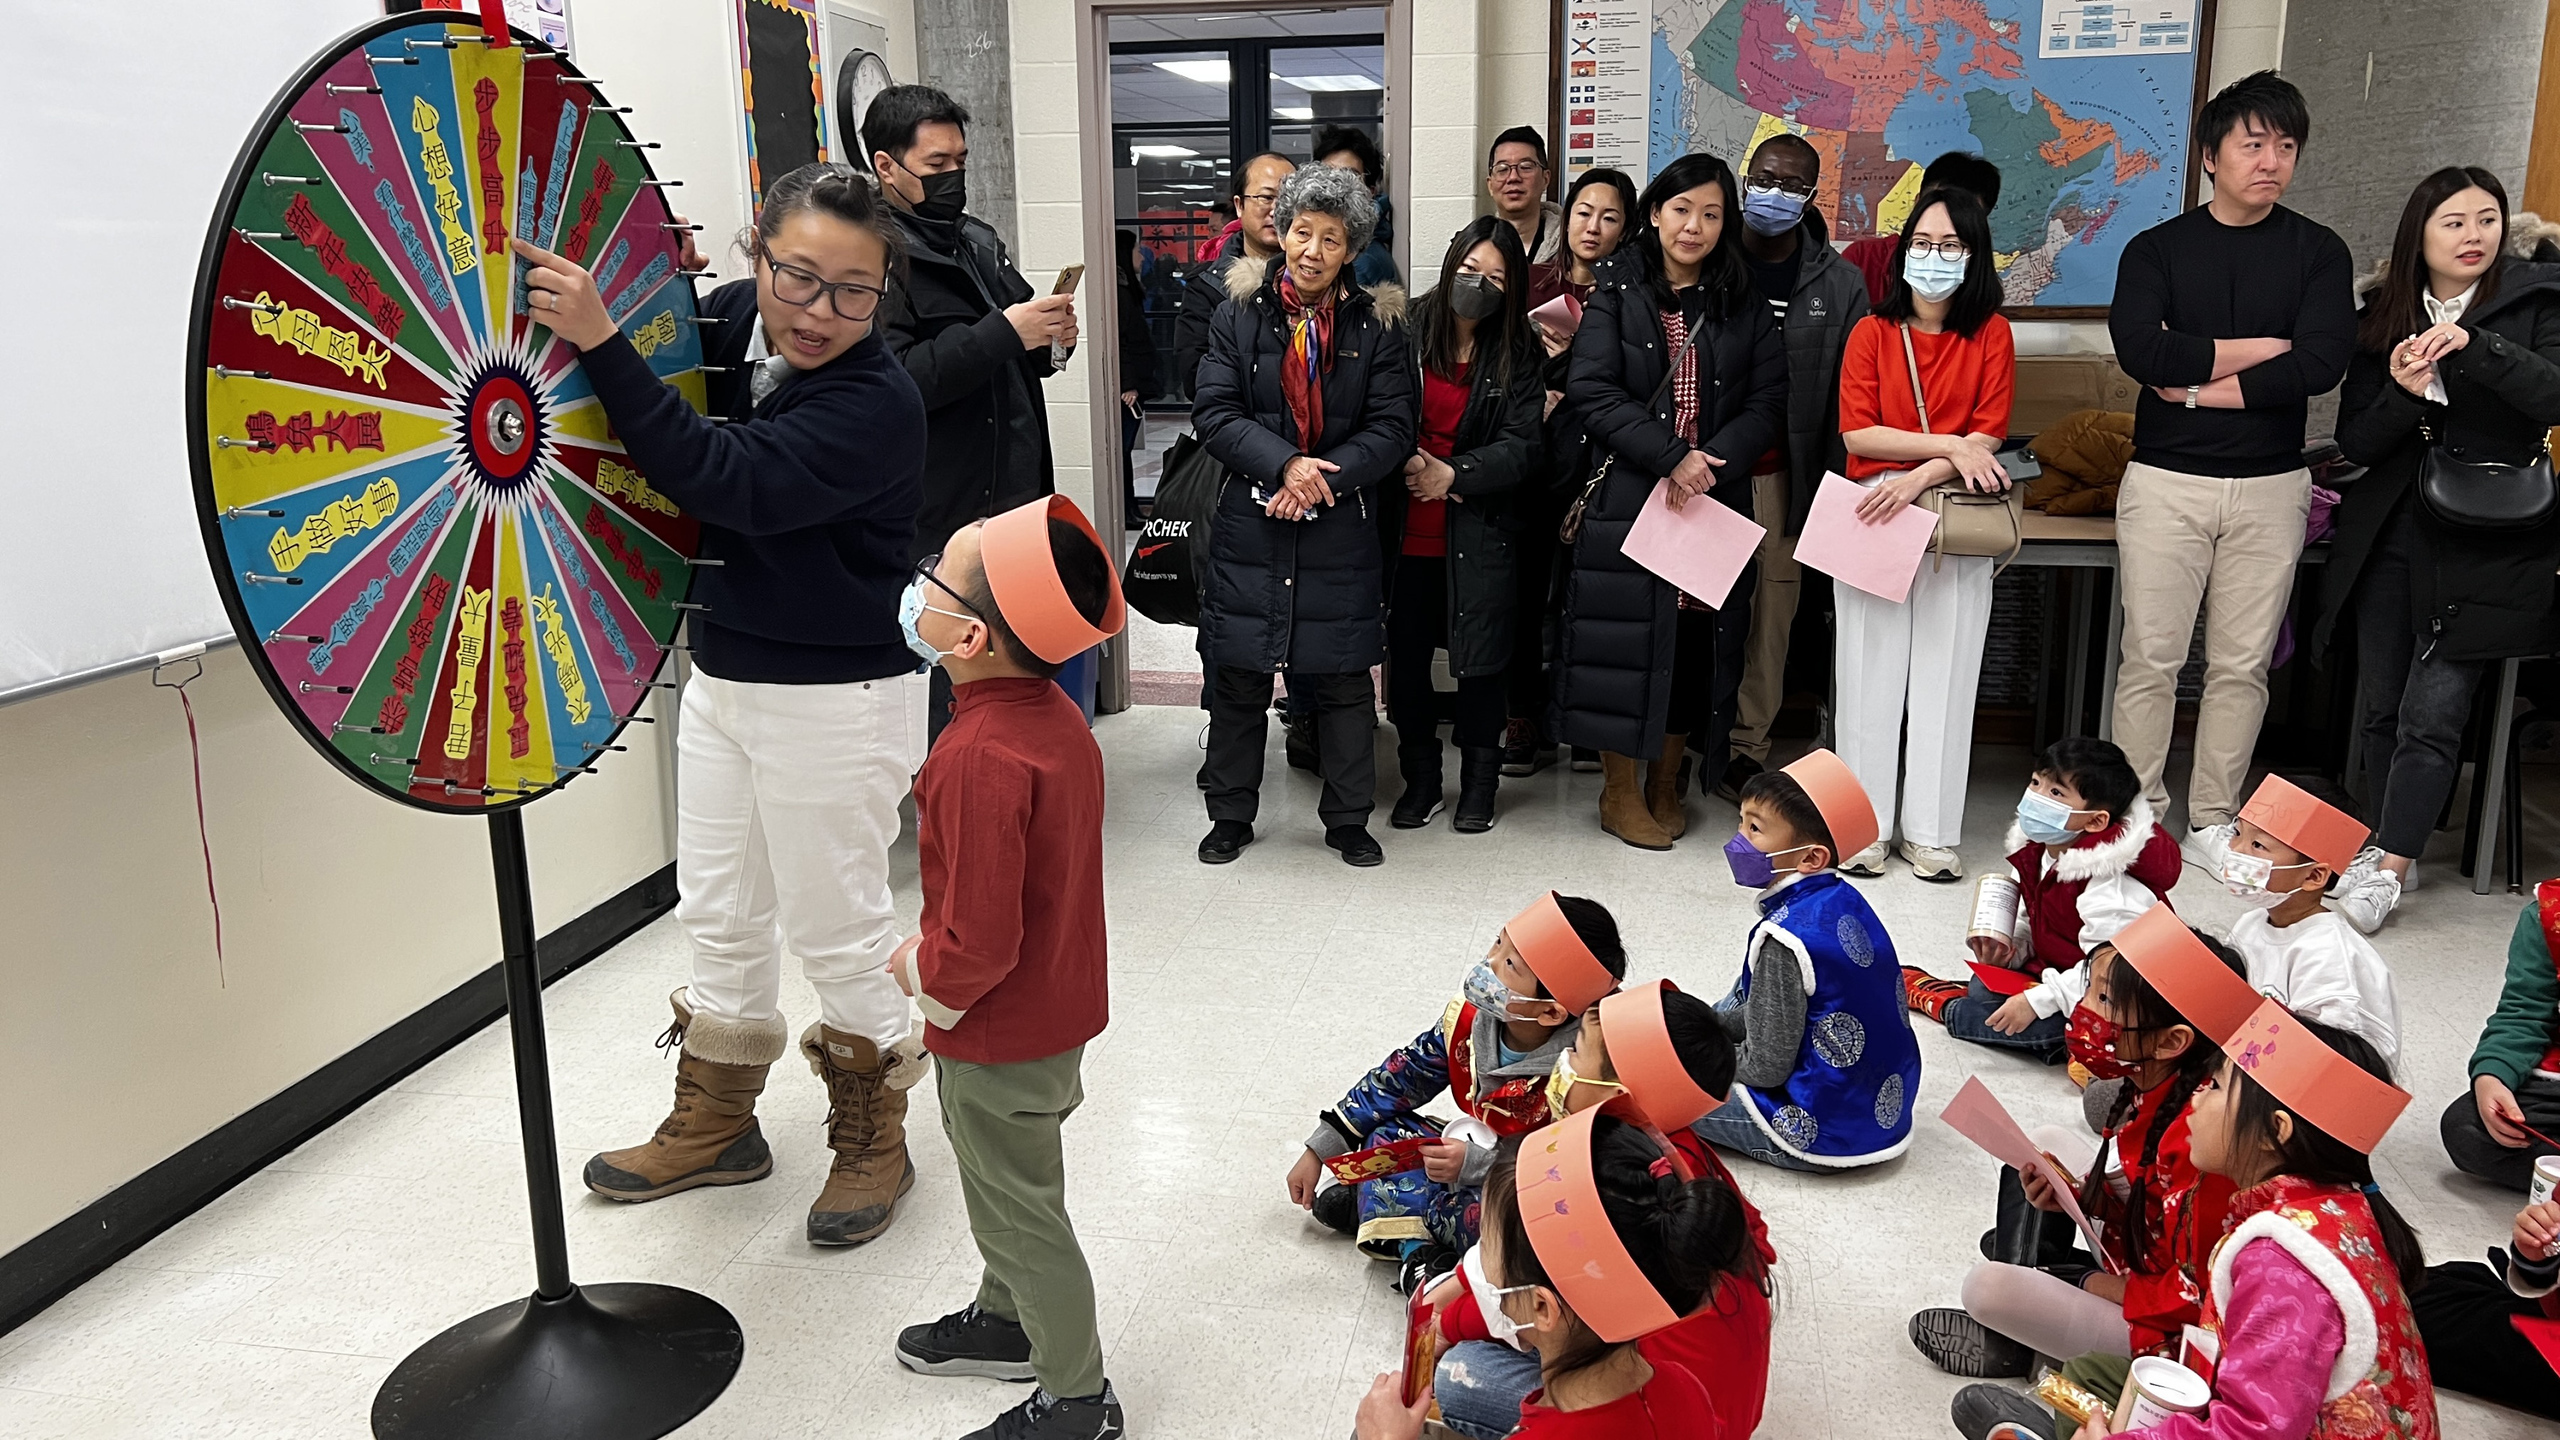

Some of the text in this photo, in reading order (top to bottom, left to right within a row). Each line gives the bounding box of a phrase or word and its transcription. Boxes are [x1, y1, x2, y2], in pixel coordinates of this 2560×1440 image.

[965, 31, 992, 58] 256
[1651, 84, 1665, 158] PACIFIC
[2138, 67, 2178, 151] ATLANTIC
[413, 98, 476, 273] 心想好意
[476, 80, 506, 254] 步步高升
[2157, 165, 2178, 224] OCEAN
[287, 199, 403, 338] 新年快樂
[256, 296, 388, 387] 父母恩大
[247, 412, 383, 453] 鴻兔大展
[270, 480, 398, 569] 手做好事
[379, 575, 451, 734] 恭喜發財
[446, 589, 490, 756] 君子量大
[500, 599, 529, 756] 玉兔迎春
[534, 586, 591, 721] 太陽光大
